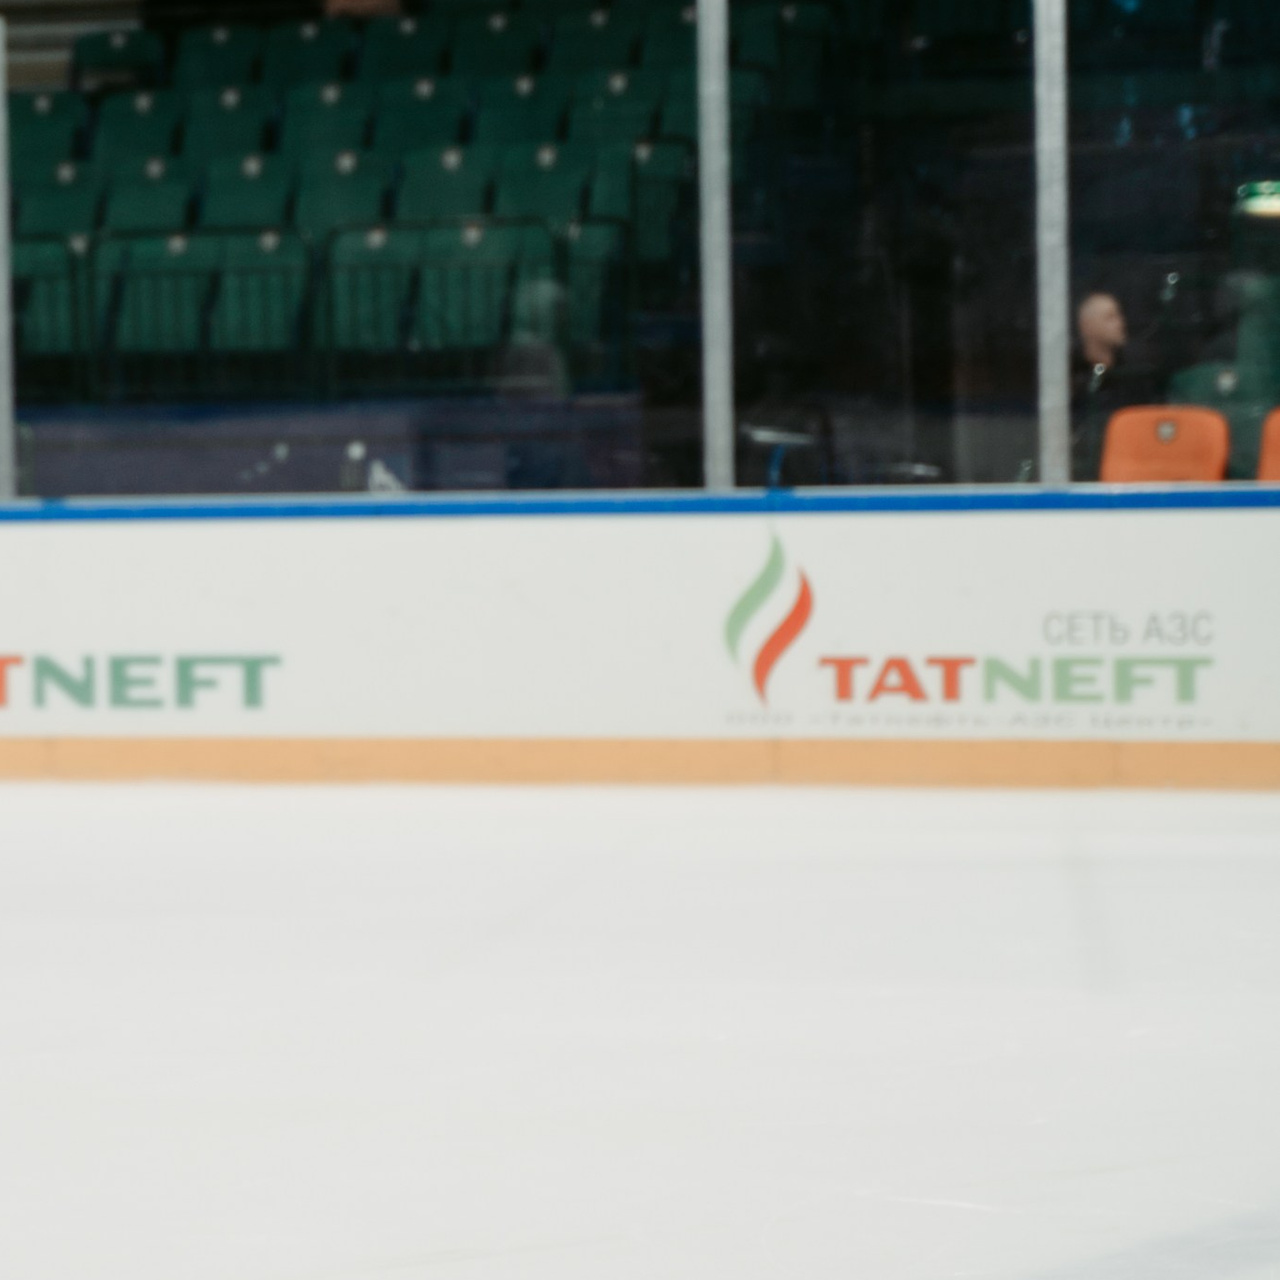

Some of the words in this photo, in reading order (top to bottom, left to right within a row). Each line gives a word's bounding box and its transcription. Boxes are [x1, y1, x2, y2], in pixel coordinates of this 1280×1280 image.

[1042, 611, 1132, 645] СЕТЬ
[1142, 611, 1214, 645] АЗС
[818, 656, 1214, 705] TATNEFT
